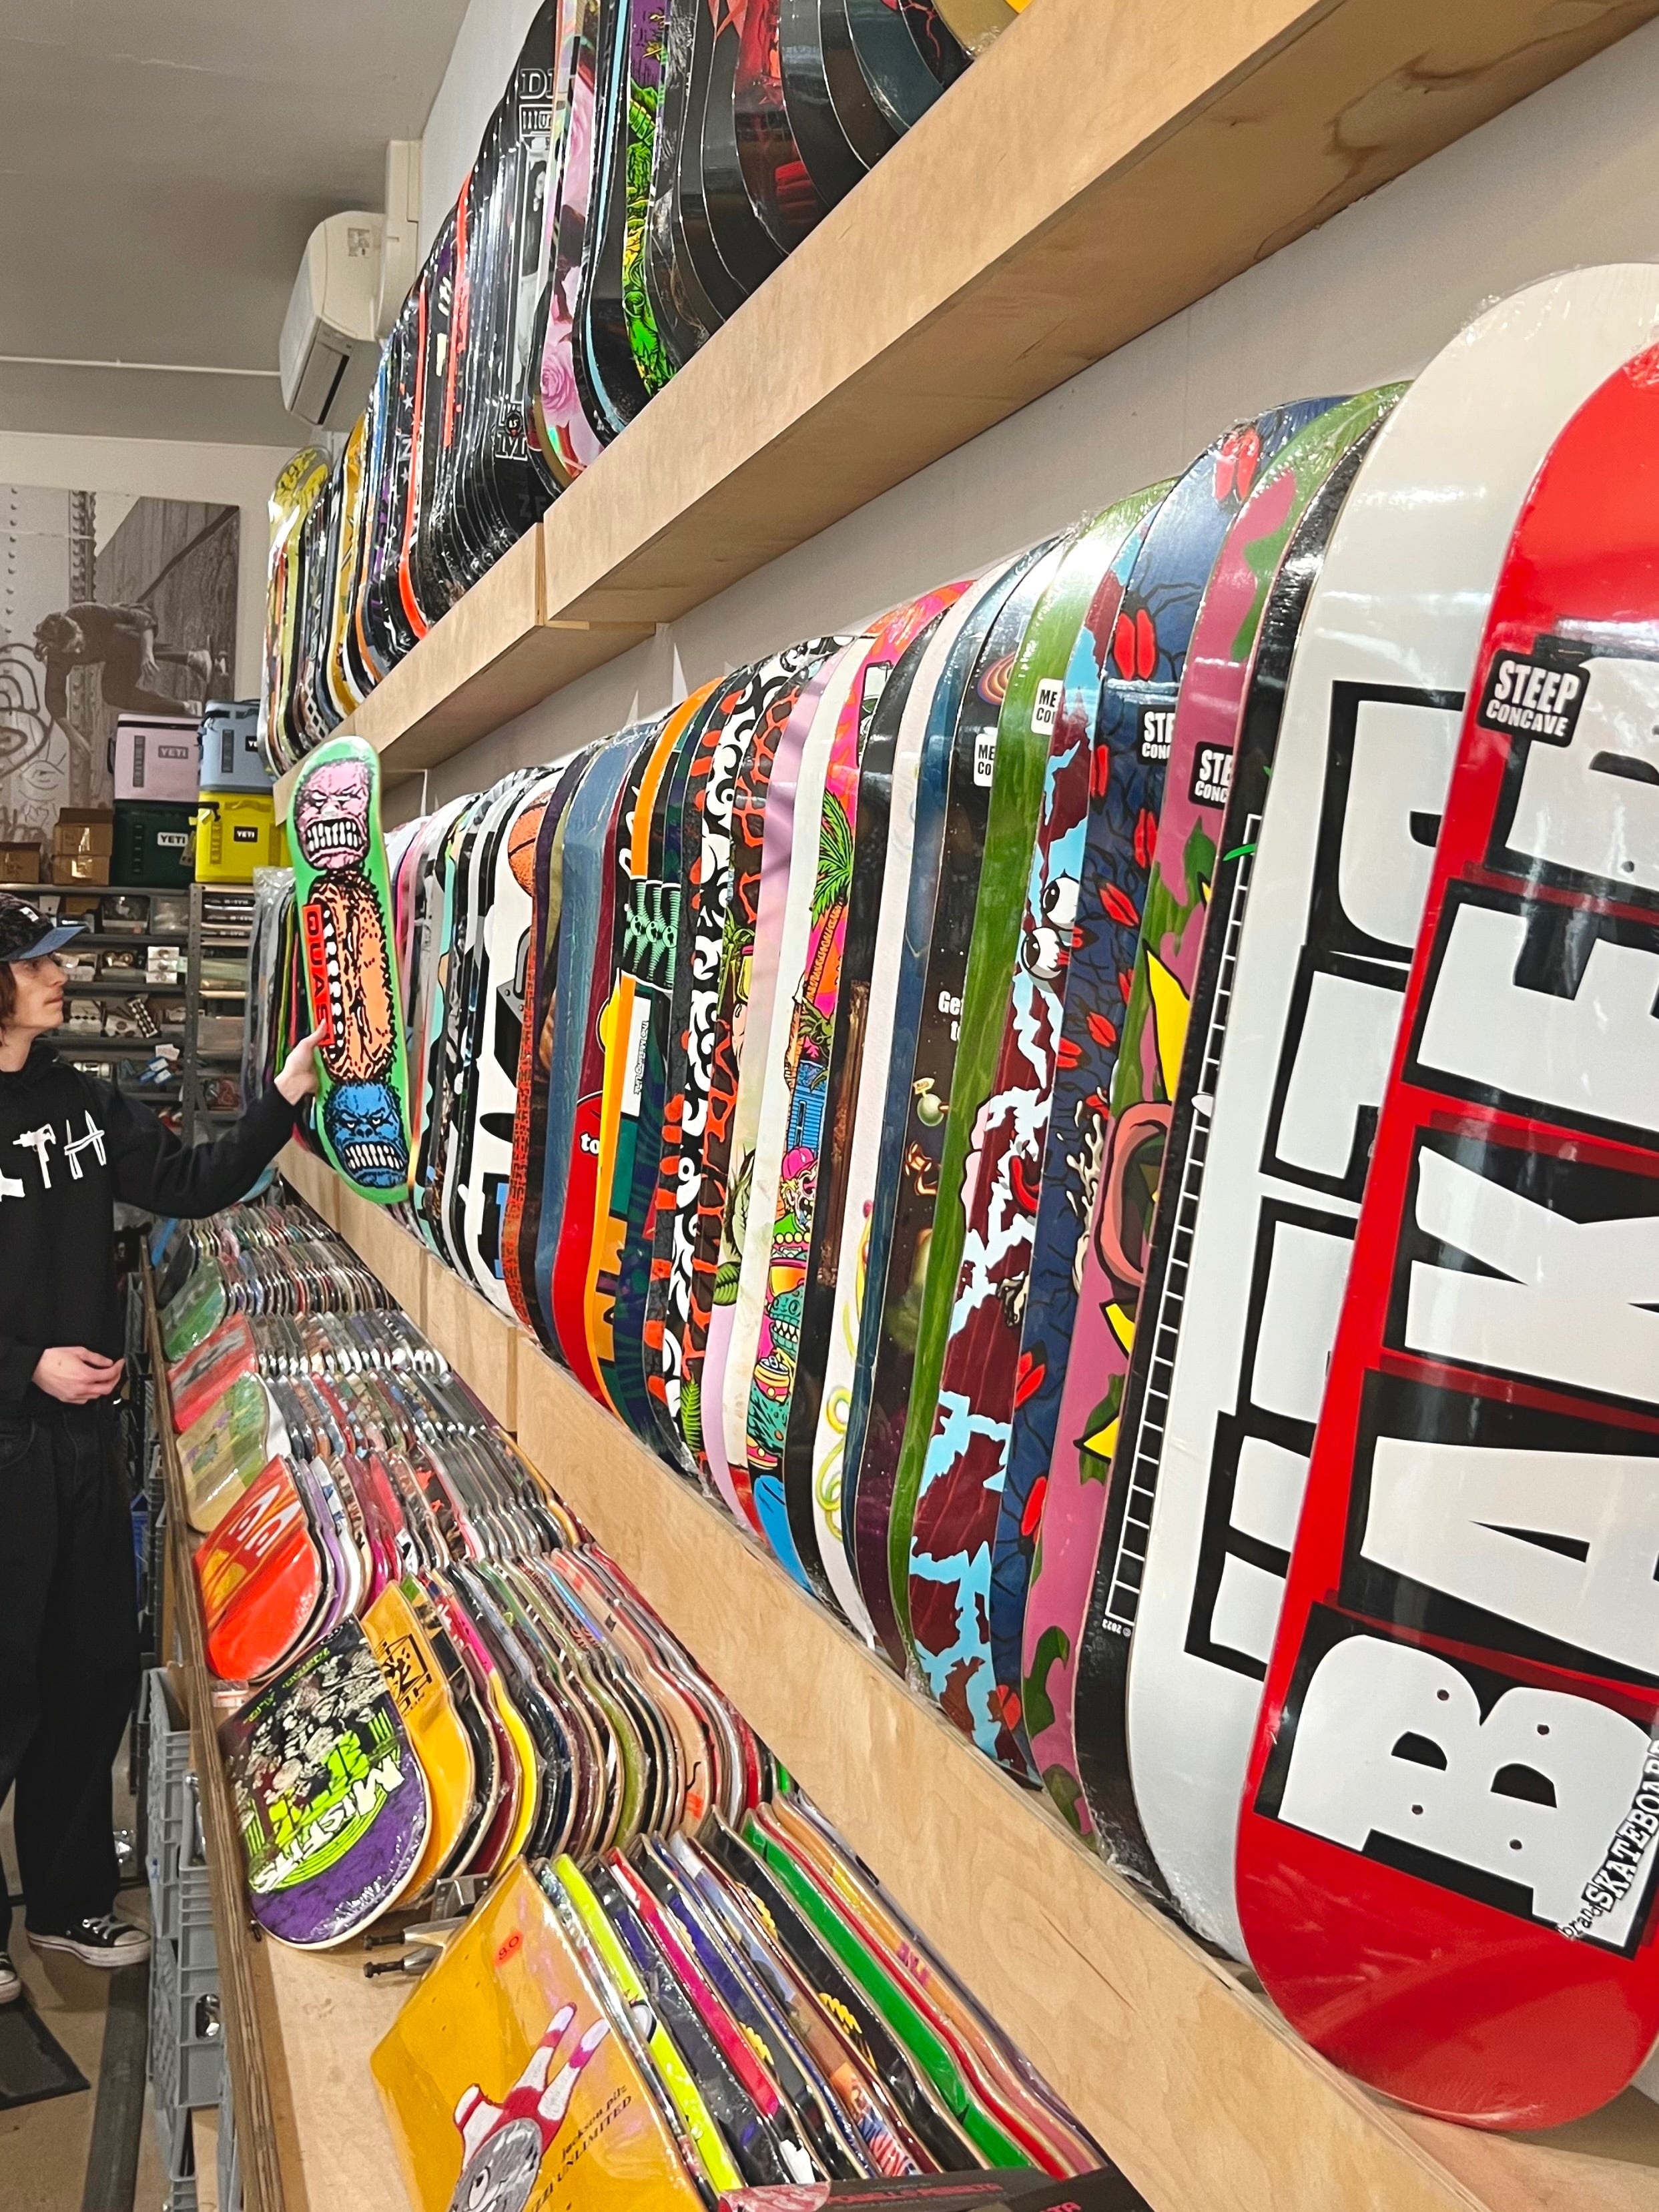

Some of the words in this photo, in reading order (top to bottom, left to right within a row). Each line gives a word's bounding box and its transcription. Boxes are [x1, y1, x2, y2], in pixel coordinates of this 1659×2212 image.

[1038, 689, 1058, 707] ME
[1494, 659, 1580, 714] STEEP
[1485, 699, 1569, 737] CONCAVE
[159, 747, 186, 757] YETI
[978, 744, 996, 761] ME
[1199, 749, 1233, 787] STE
[160, 835, 186, 844] YETI
[938, 990, 964, 1016] Ge
[1556, 1900, 1604, 1941] brand
[555, 2095, 633, 2183] UNLIMITED
